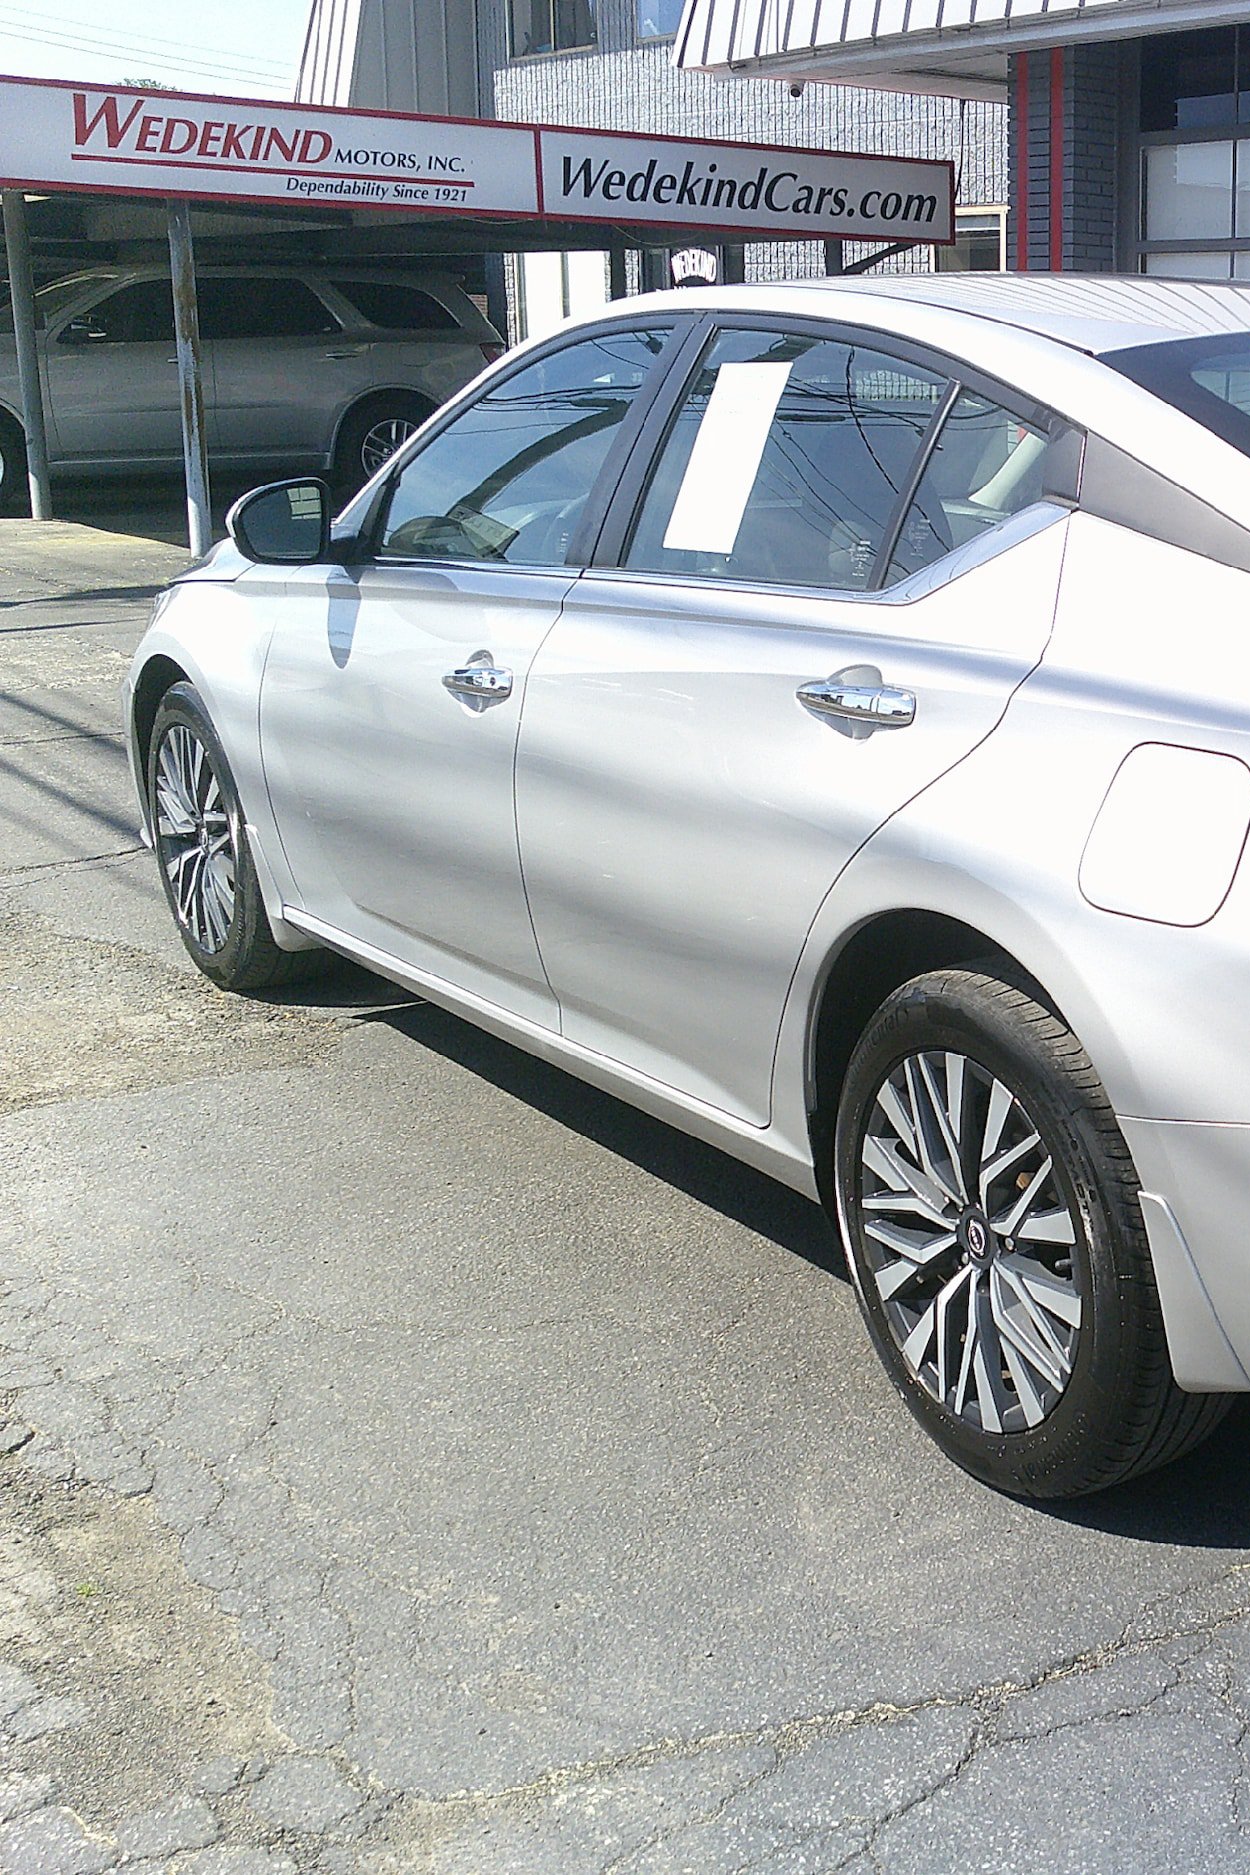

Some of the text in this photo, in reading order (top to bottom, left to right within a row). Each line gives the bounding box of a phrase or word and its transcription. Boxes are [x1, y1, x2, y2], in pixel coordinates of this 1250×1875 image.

[73, 93, 466, 173] WEDEKIND MOTORS, INC.
[286, 177, 467, 202] Dependability Since 1921
[561, 155, 938, 223] WedekindCars.com
